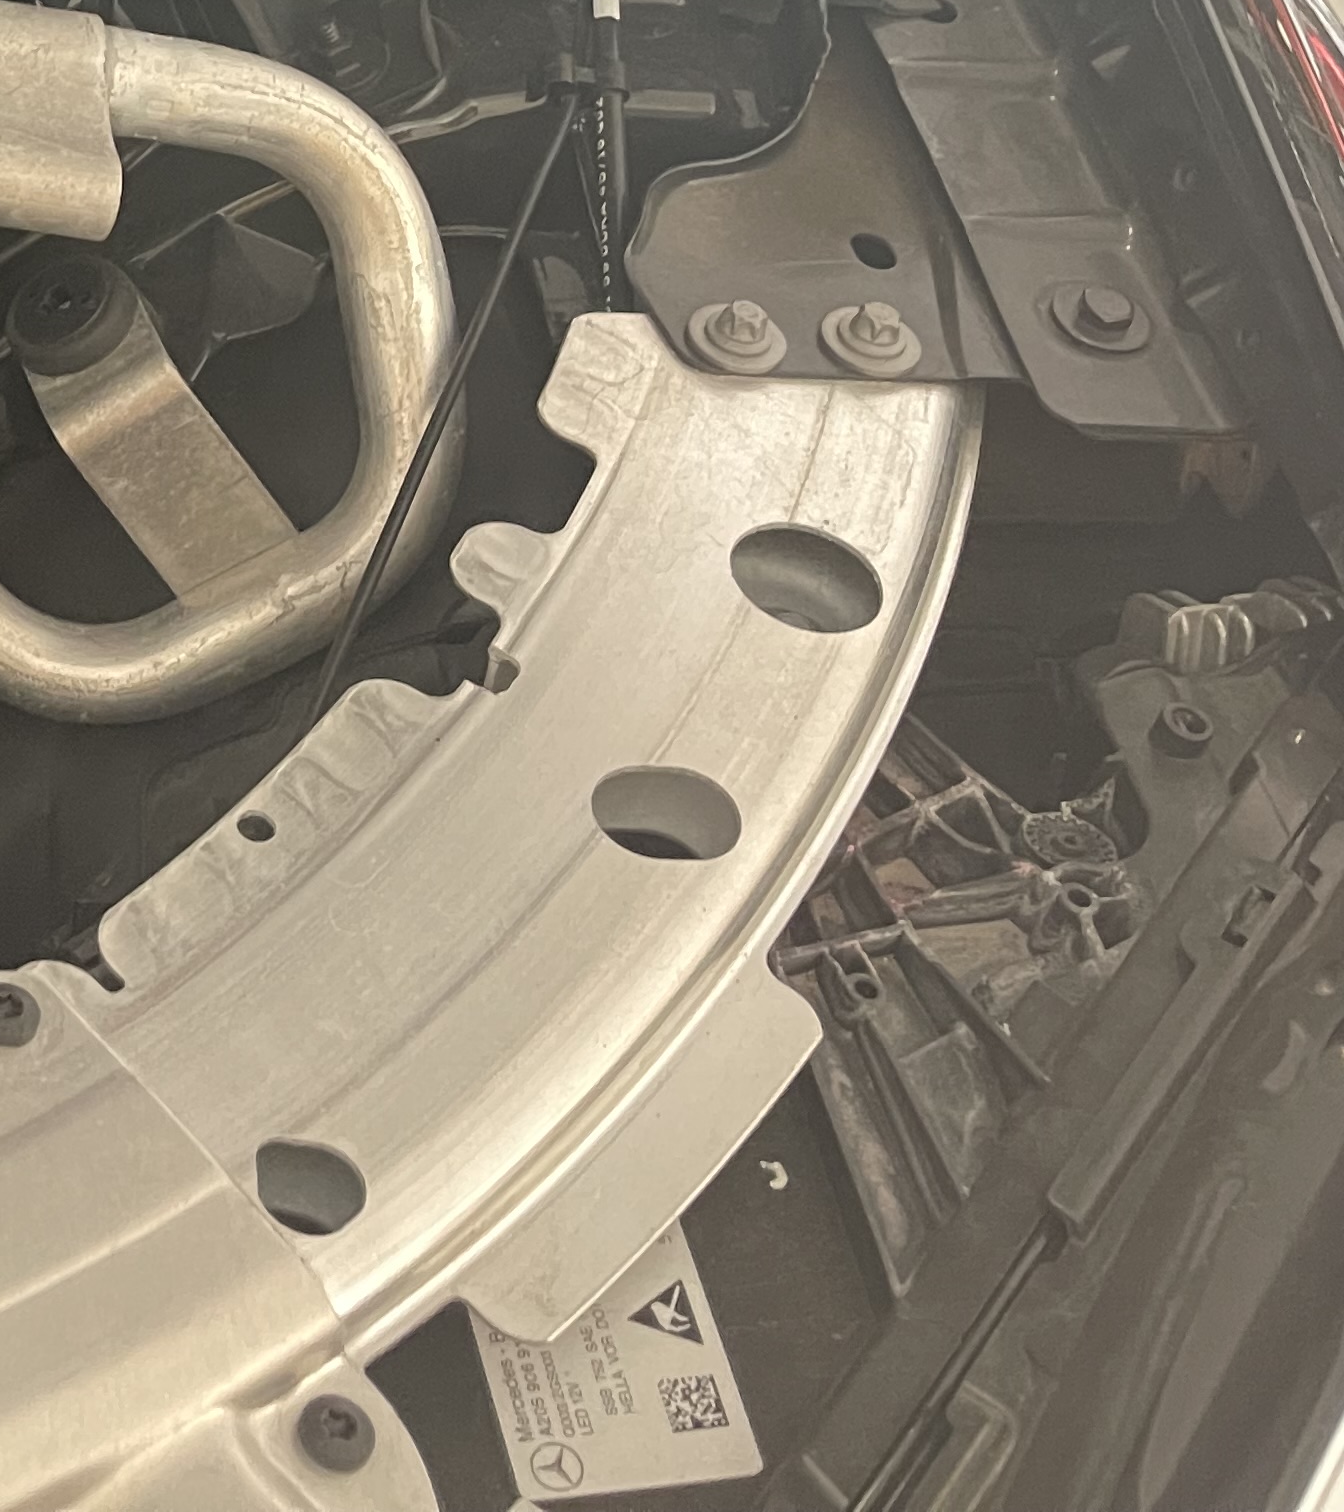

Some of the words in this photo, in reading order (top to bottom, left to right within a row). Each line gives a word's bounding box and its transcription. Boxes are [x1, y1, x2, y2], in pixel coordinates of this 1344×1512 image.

[488, 1331, 506, 1343] B
[500, 1357, 535, 1443] Mercedes
[612, 1369, 636, 1415] HELLA
[573, 1408, 595, 1437] LED
